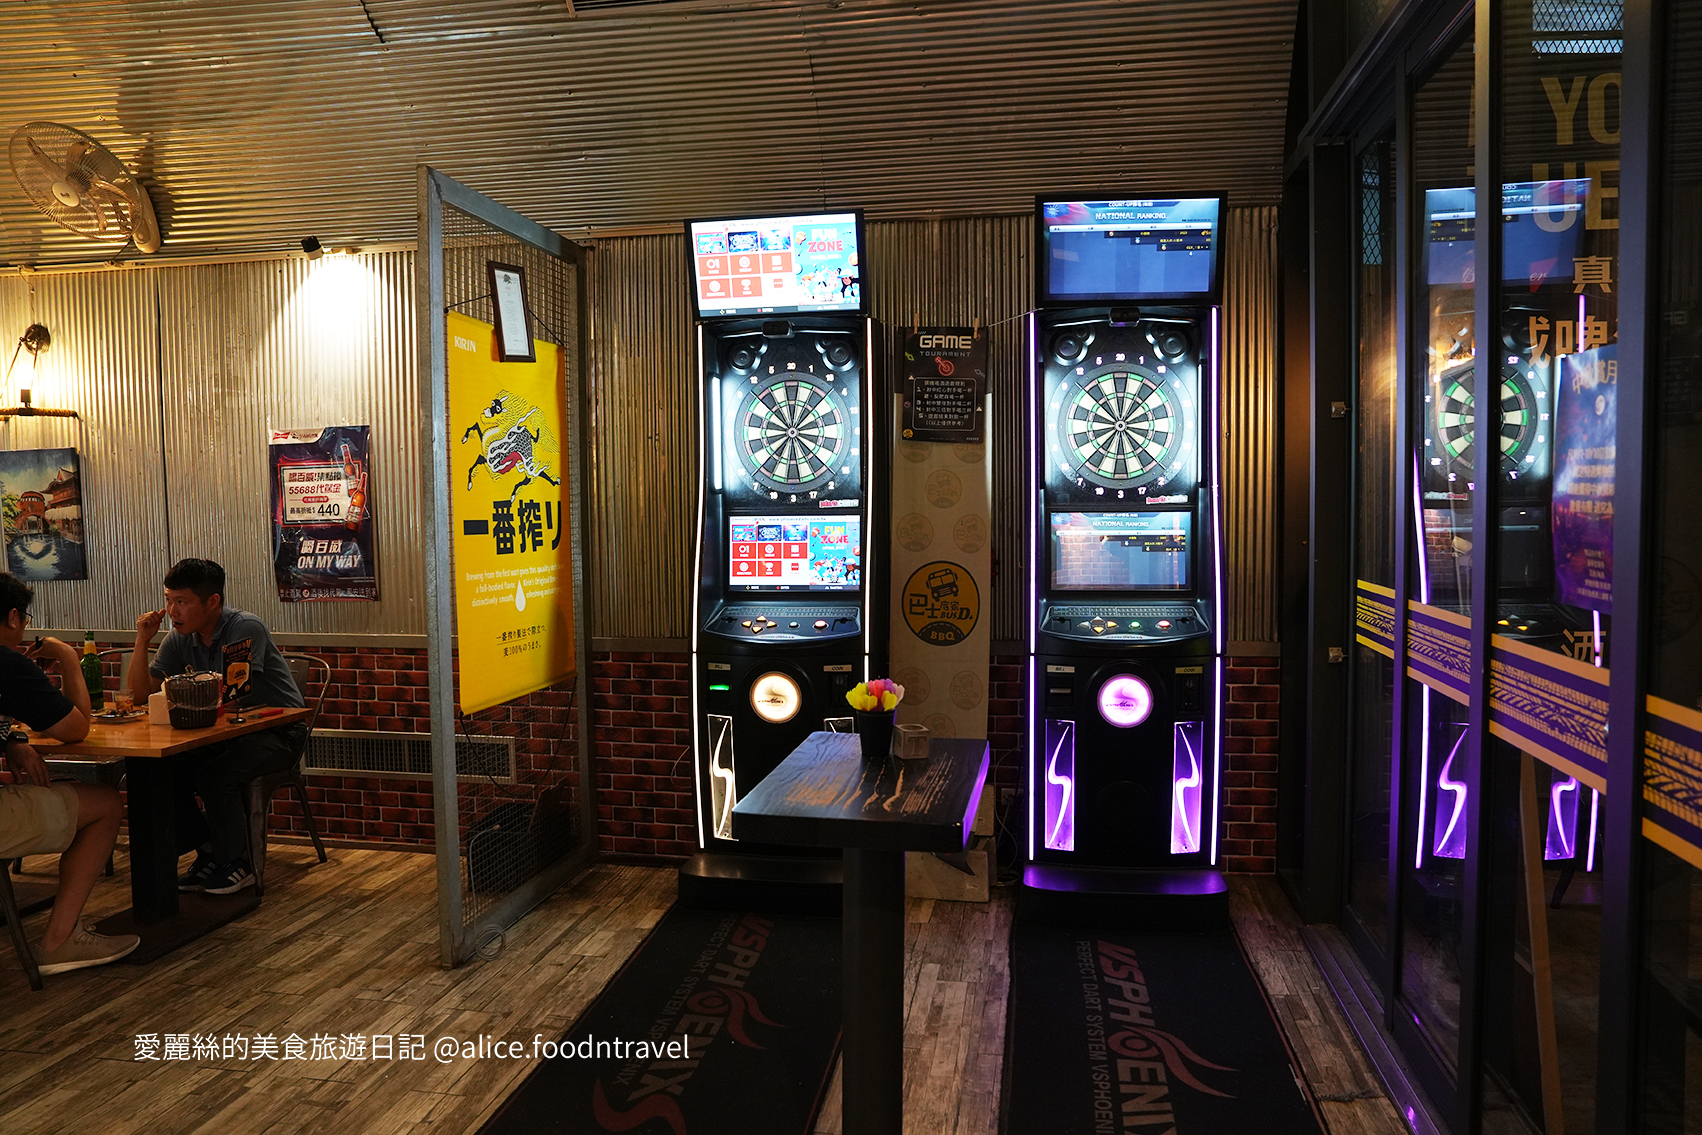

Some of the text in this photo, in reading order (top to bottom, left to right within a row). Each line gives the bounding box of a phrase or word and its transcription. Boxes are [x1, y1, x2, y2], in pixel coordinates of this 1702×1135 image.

[1095, 211, 1167, 221] NATIONAL RANKING
[811, 228, 838, 241] FUN
[807, 240, 844, 253] ZONE
[1573, 255, 1613, 294] 真
[454, 335, 476, 353] KIRIN
[919, 335, 972, 349] GAME
[1096, 357, 1102, 365] 5
[1116, 353, 1126, 361] 20
[1139, 355, 1145, 364] 1
[768, 366, 775, 374] 5
[786, 362, 797, 370] 20
[809, 364, 814, 373] 1
[1076, 367, 1084, 375] 12
[750, 376, 758, 384] 12
[841, 388, 848, 396] 4
[828, 482, 835, 490] 2
[1077, 478, 1084, 486] 7
[1158, 477, 1165, 485] 2
[809, 491, 818, 499] 17
[1118, 490, 1124, 499] 3
[1138, 487, 1147, 495] 17
[317, 503, 340, 516] 440
[463, 499, 562, 556] 一番搾り
[824, 525, 845, 535] FUN
[820, 535, 849, 544] ZONE
[300, 540, 343, 554] 喝百威
[298, 554, 361, 569] ON MY WAY
[466, 572, 484, 582] Brewing
[484, 571, 495, 579] from
[502, 569, 510, 577] first
[519, 568, 529, 577] gives
[537, 564, 551, 574] quality
[479, 582, 504, 593] full-bodied
[535, 577, 549, 587] Original
[472, 597, 498, 607] distinctively
[909, 593, 941, 620] 巴士
[930, 630, 956, 642] BBQ
[706, 913, 740, 948] PERFECT
[691, 950, 719, 974] DART
[1076, 940, 1097, 981] PERFECT
[661, 976, 700, 1015] SYSTEM
[1082, 983, 1102, 1011] DART
[1085, 1014, 1107, 1060] SYSTEM
